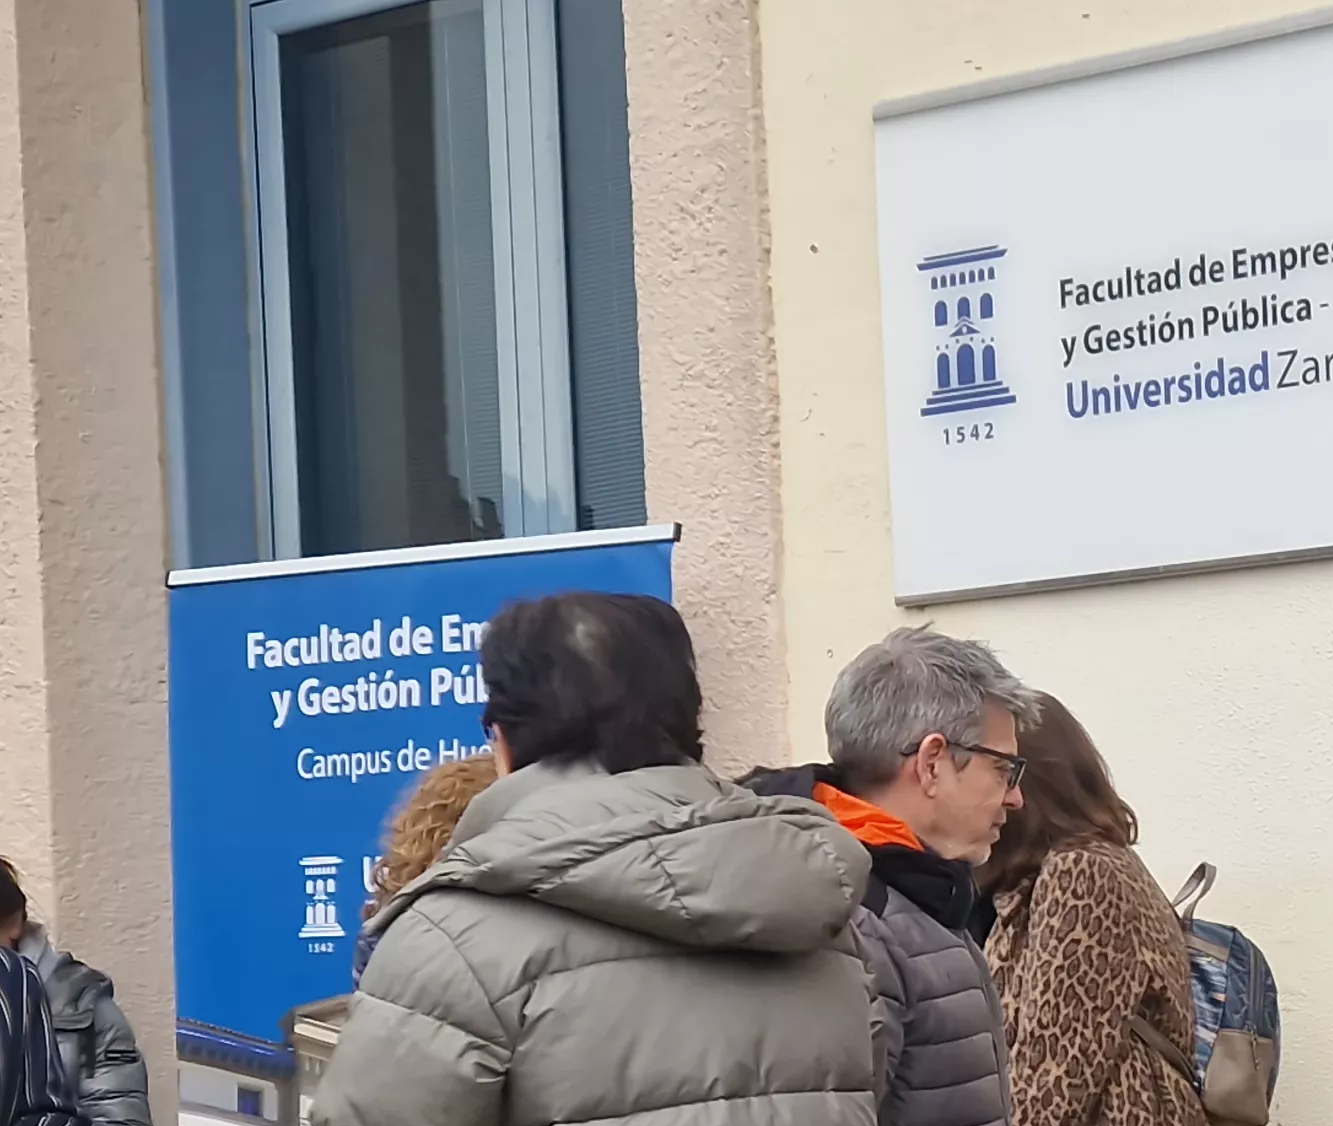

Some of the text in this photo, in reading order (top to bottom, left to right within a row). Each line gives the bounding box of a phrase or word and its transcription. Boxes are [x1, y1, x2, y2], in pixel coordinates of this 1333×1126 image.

[1059, 257, 1182, 309] Facultad
[1188, 253, 1225, 287] de
[1060, 335, 1077, 369] y
[1083, 311, 1195, 355] Gestión
[1202, 293, 1312, 337] Pública
[1066, 350, 1270, 419] Universidad
[943, 422, 995, 446] 1542
[247, 613, 493, 669] Facultad de Em
[270, 690, 292, 729] y
[297, 669, 421, 716] Gestión
[297, 748, 392, 783] Campus
[397, 739, 432, 772] de
